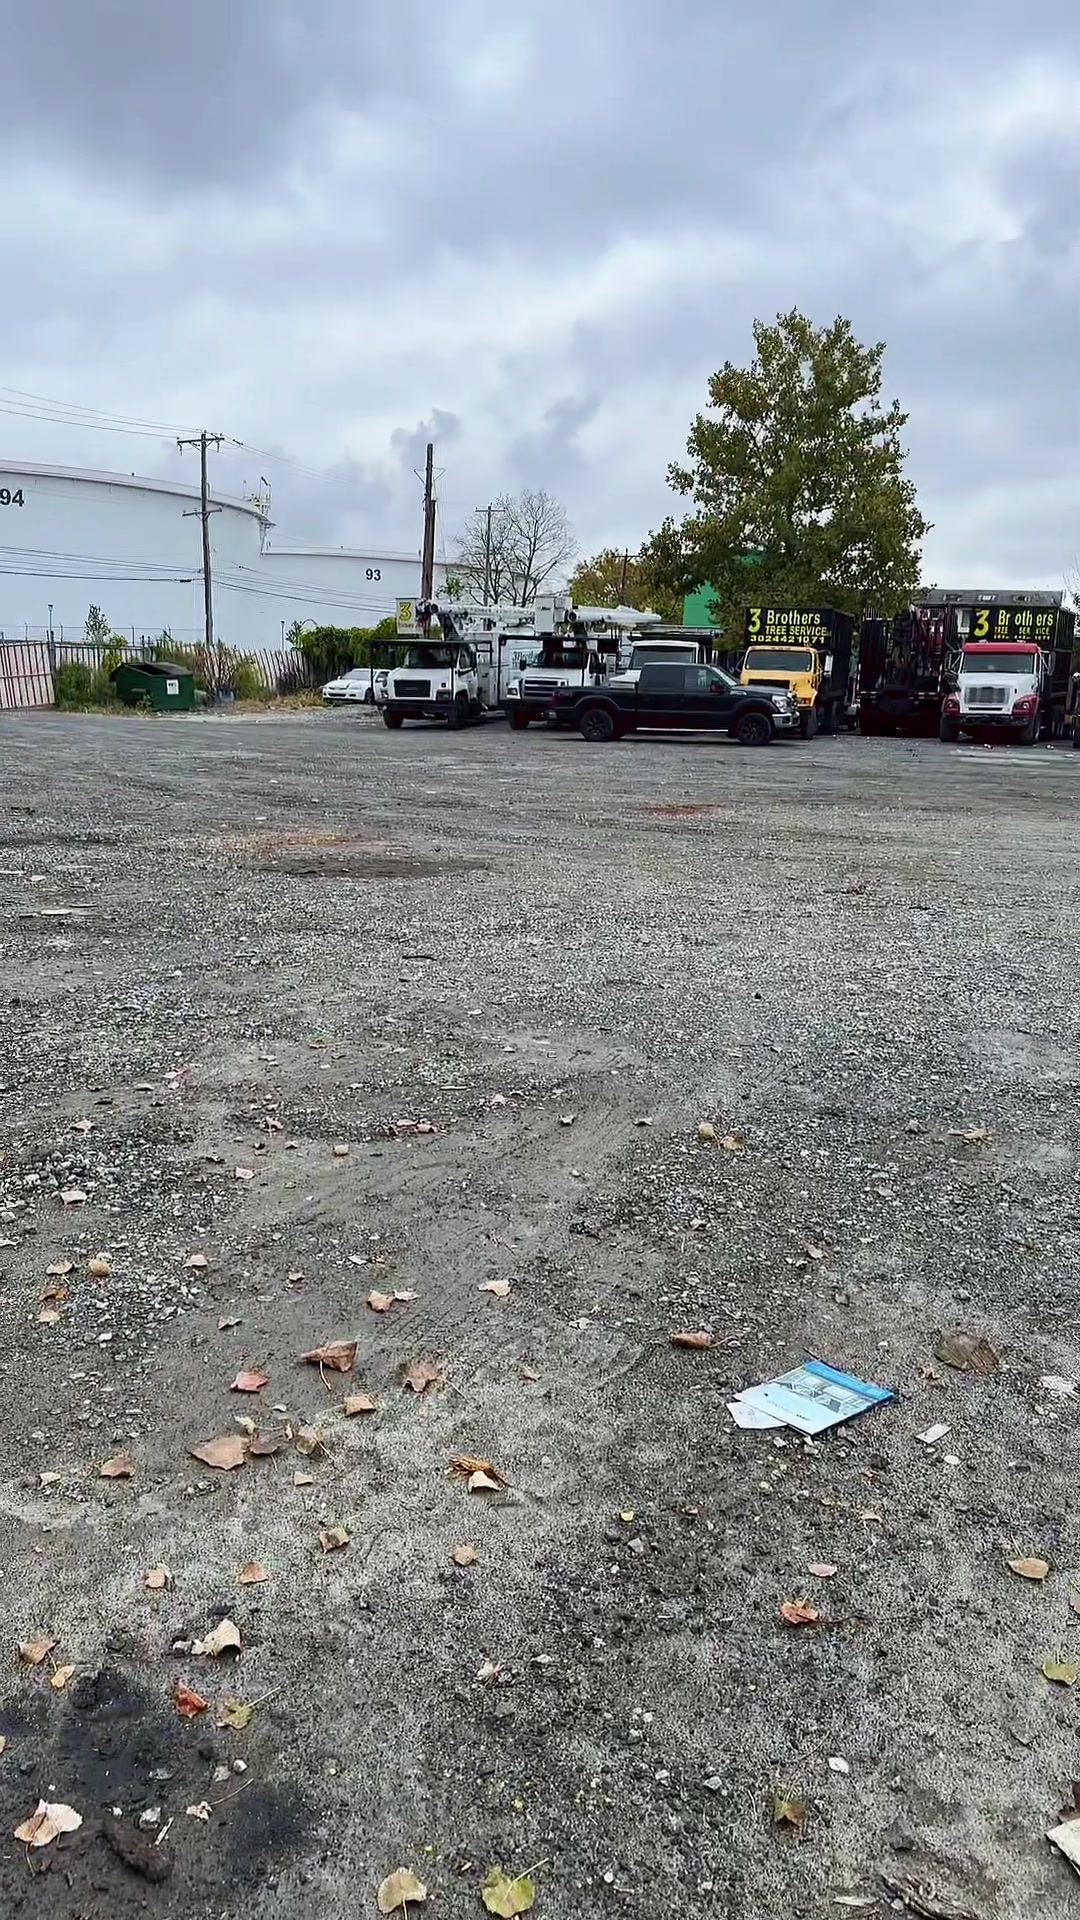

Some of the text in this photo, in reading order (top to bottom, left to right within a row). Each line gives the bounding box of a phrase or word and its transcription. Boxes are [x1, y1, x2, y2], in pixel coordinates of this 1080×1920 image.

[0, 488, 25, 507] 94
[365, 568, 382, 581] 93
[399, 601, 412, 622] 3
[747, 608, 821, 633] 3 Brothers
[765, 625, 828, 636] TREE SERVICE
[974, 609, 990, 637] 3
